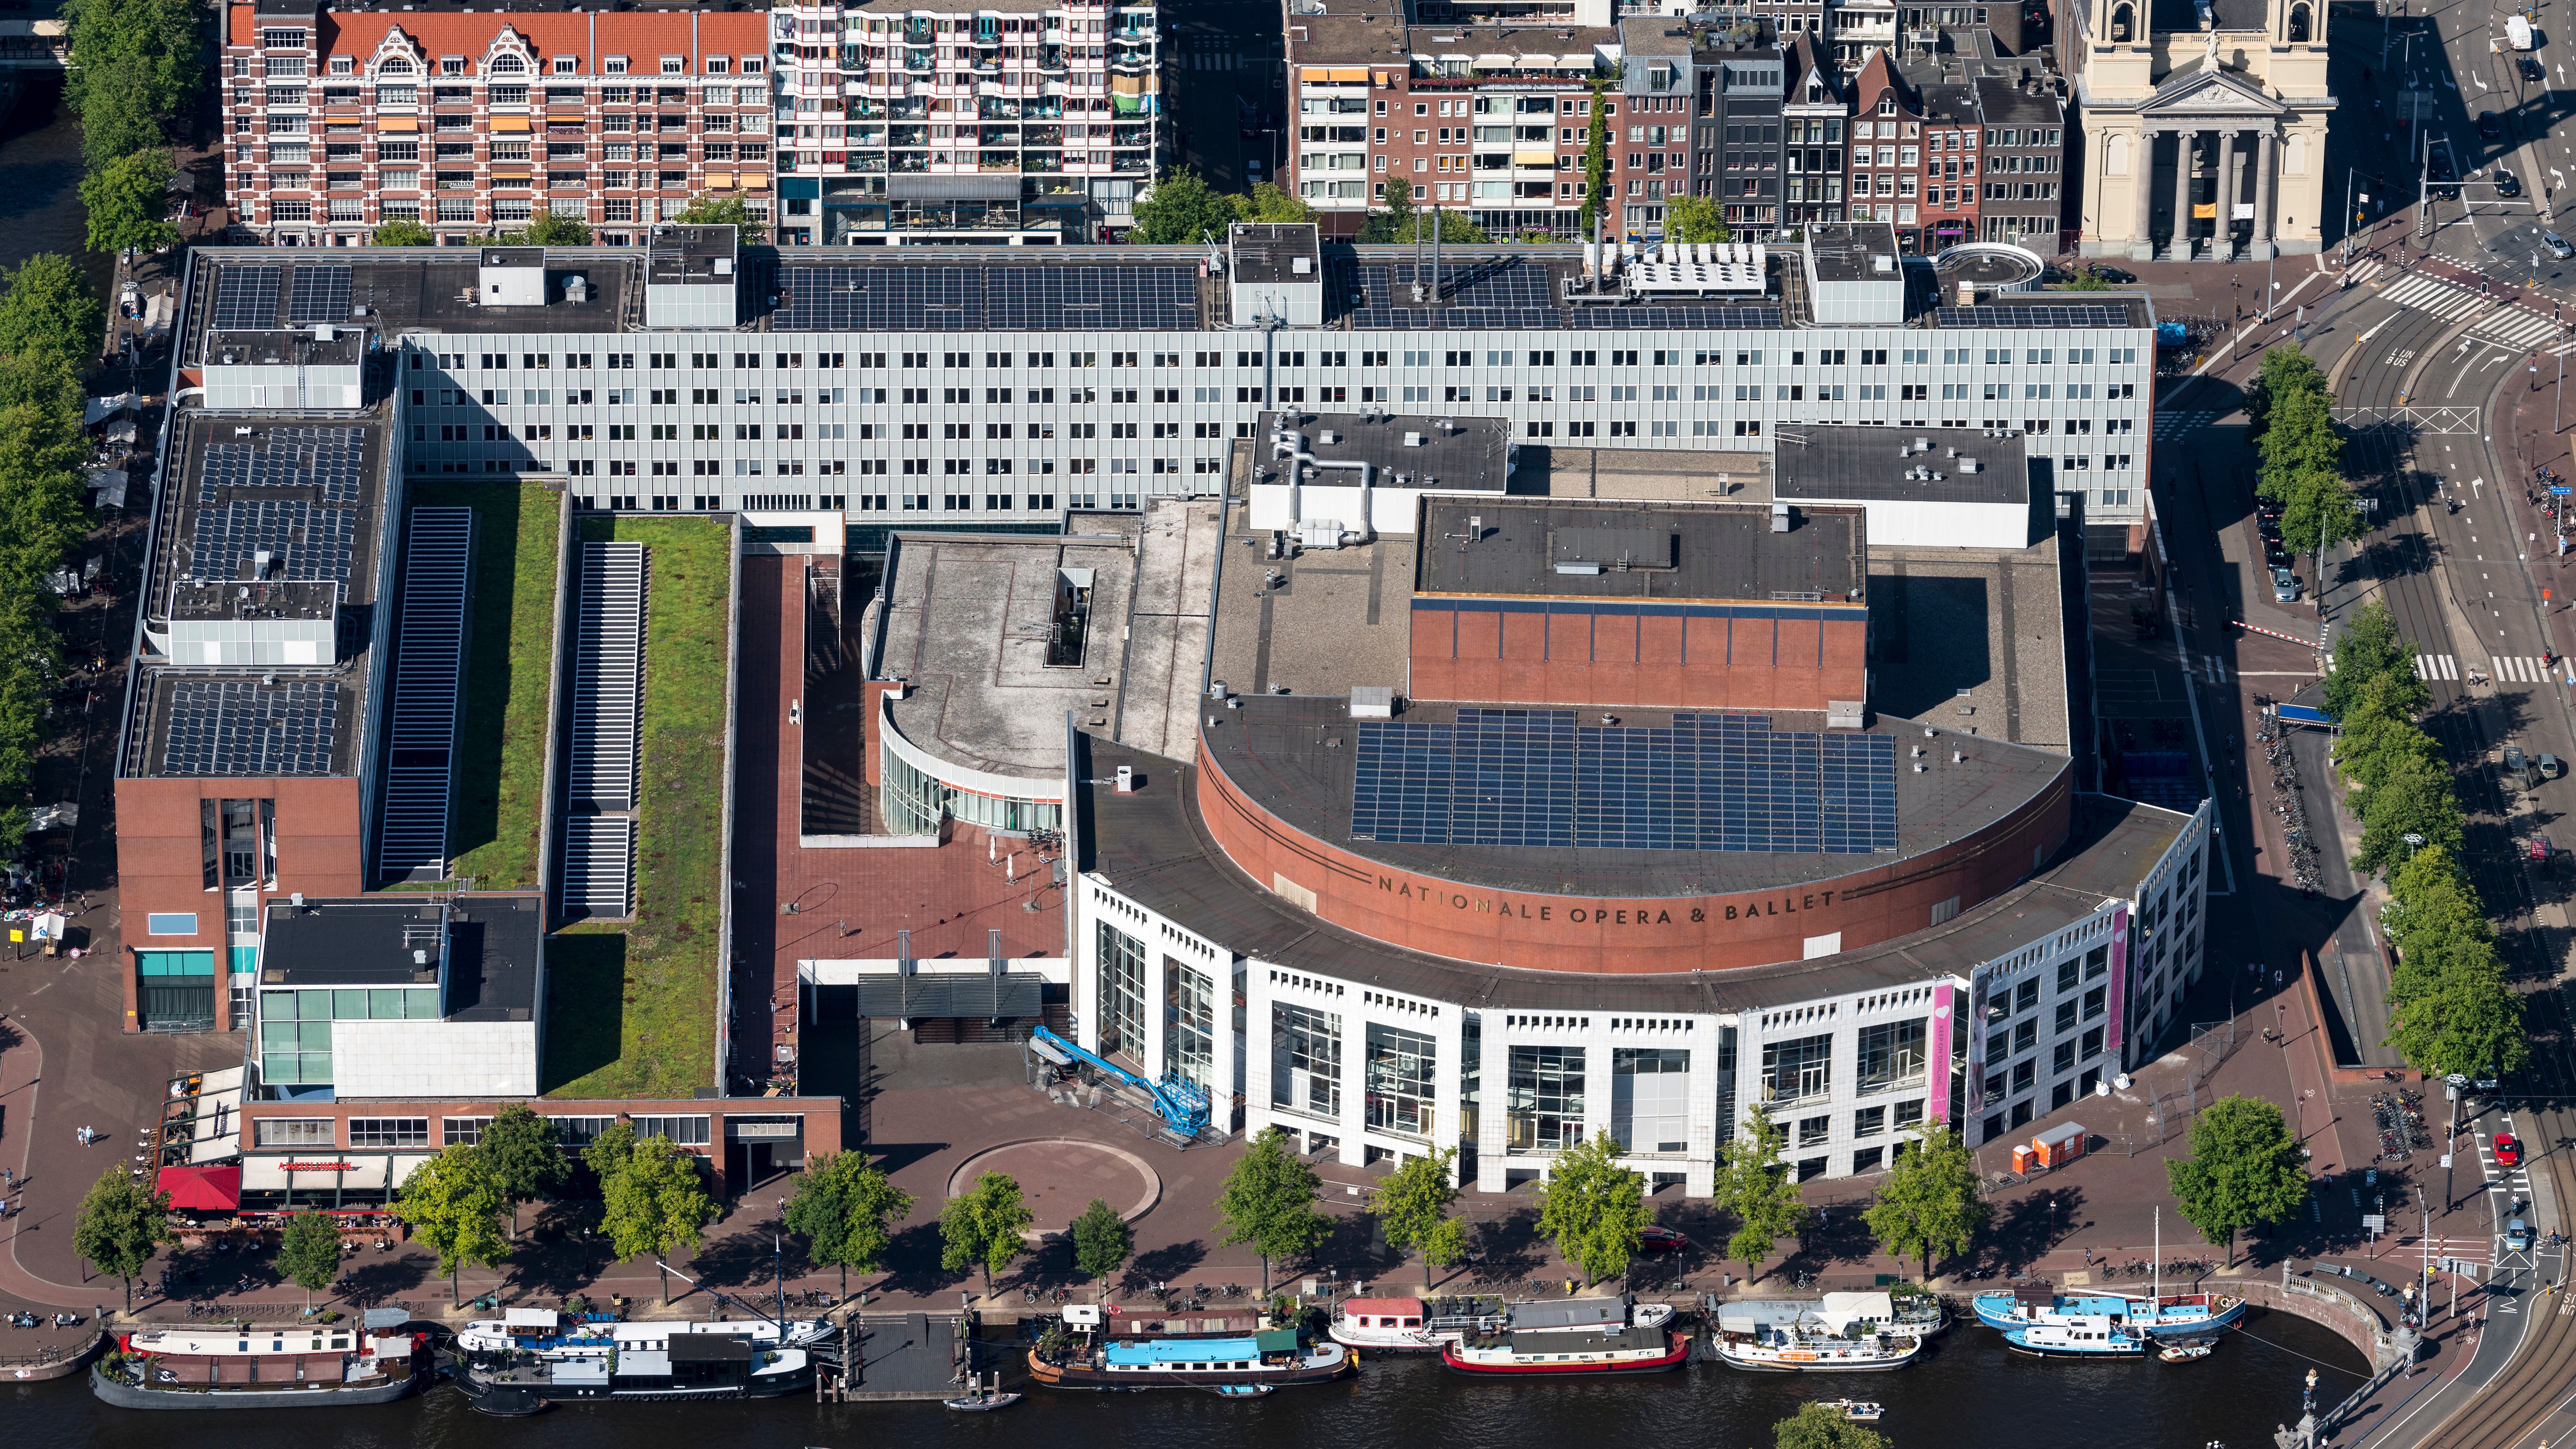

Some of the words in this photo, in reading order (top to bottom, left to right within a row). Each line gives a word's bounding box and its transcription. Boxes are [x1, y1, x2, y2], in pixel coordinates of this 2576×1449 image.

[2391, 348, 2416, 359] LIJN
[2385, 356, 2408, 366] BUS
[1379, 875, 1551, 921] NATIONALE
[1569, 908, 1671, 924] OPERA
[1690, 908, 1705, 922] &
[1725, 891, 1834, 920] BALLET
[1938, 1043, 1943, 1053] ON
